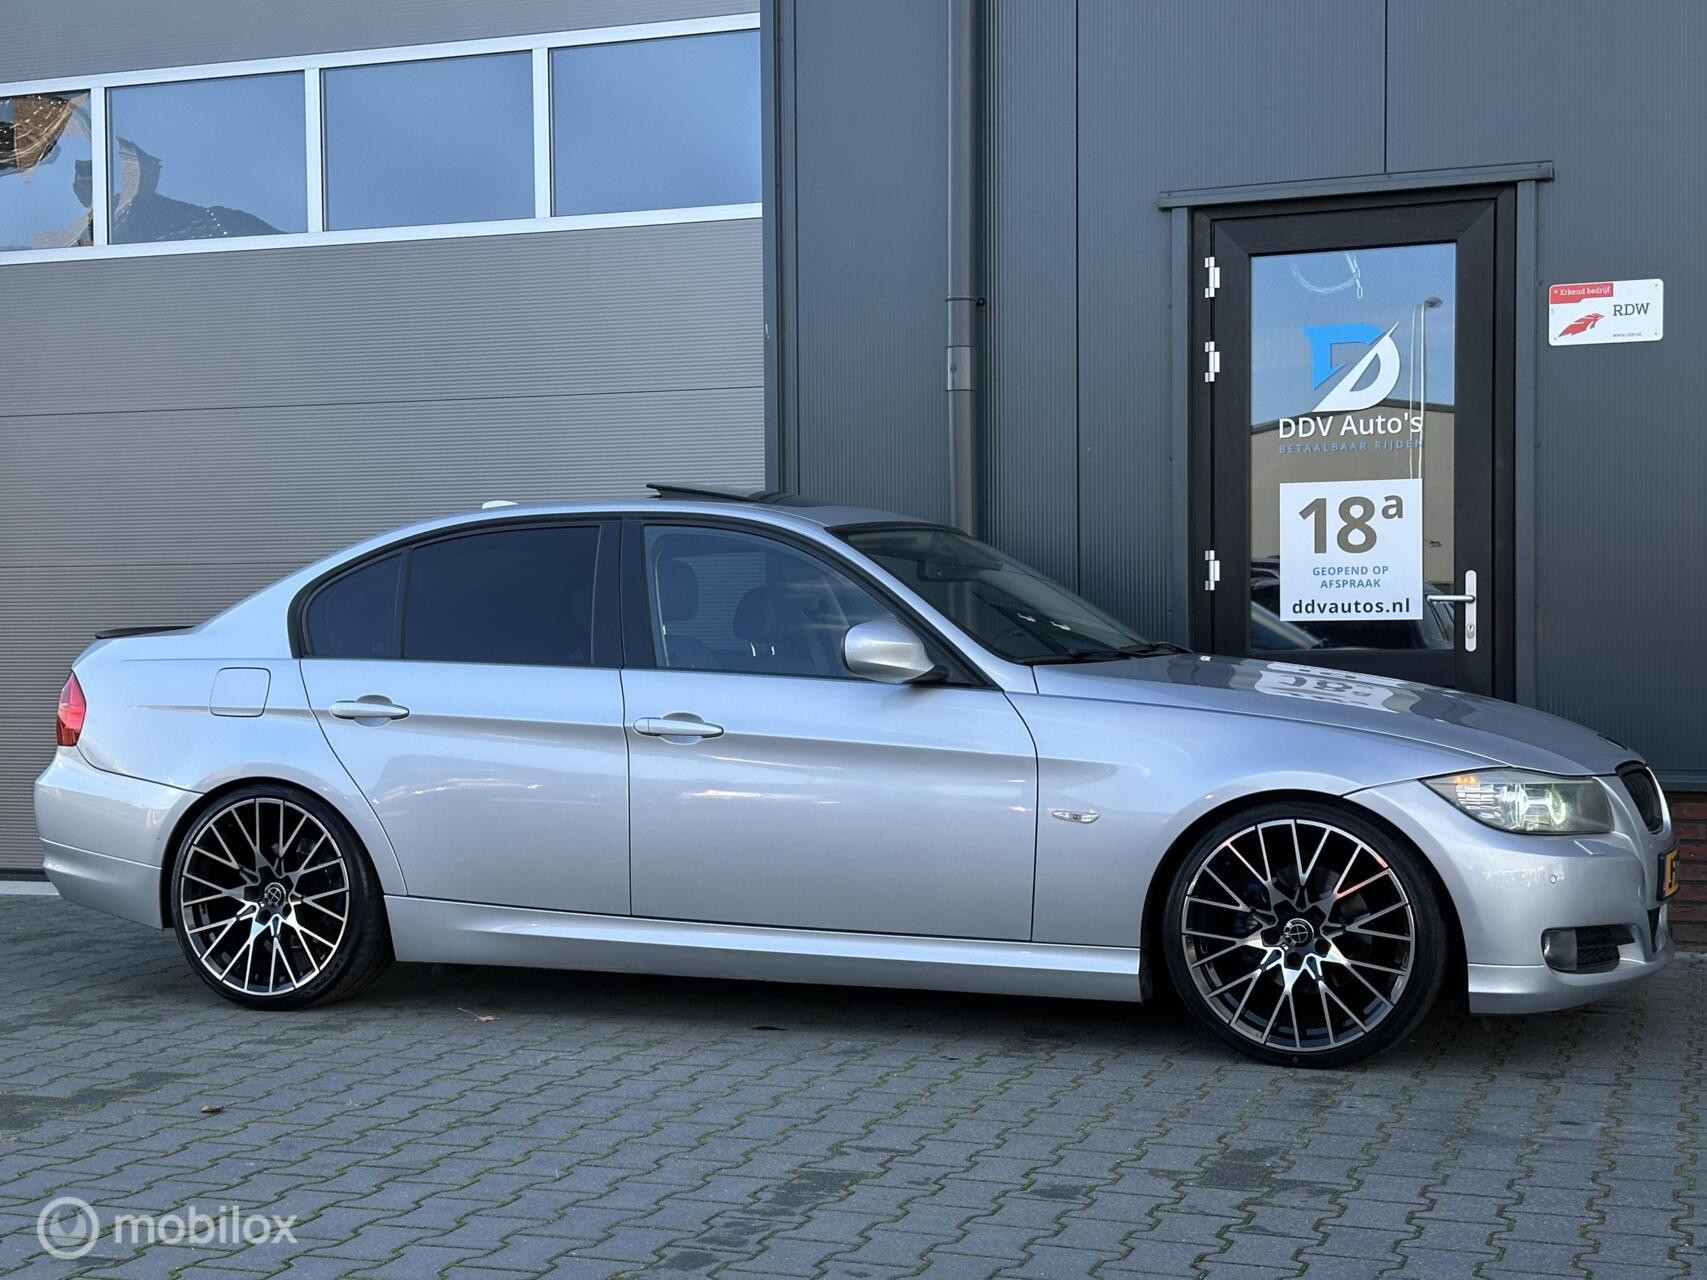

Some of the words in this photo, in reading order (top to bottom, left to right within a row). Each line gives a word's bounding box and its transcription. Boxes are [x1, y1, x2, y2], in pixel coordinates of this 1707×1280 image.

[1560, 288, 1585, 296] Erkend
[1587, 286, 1611, 296] bedrijf
[1613, 302, 1650, 317] RDW
[1279, 416, 1334, 439] DDV
[1340, 412, 1423, 436] Auto's
[1279, 441, 1367, 454] BETAALBAAR
[1375, 438, 1424, 450] RIJDEN
[1313, 566, 1369, 577] GEOPEND
[1373, 565, 1389, 575] OP
[1320, 578, 1381, 589] AFSPRAAK
[1292, 598, 1410, 614] ddvautos.nl
